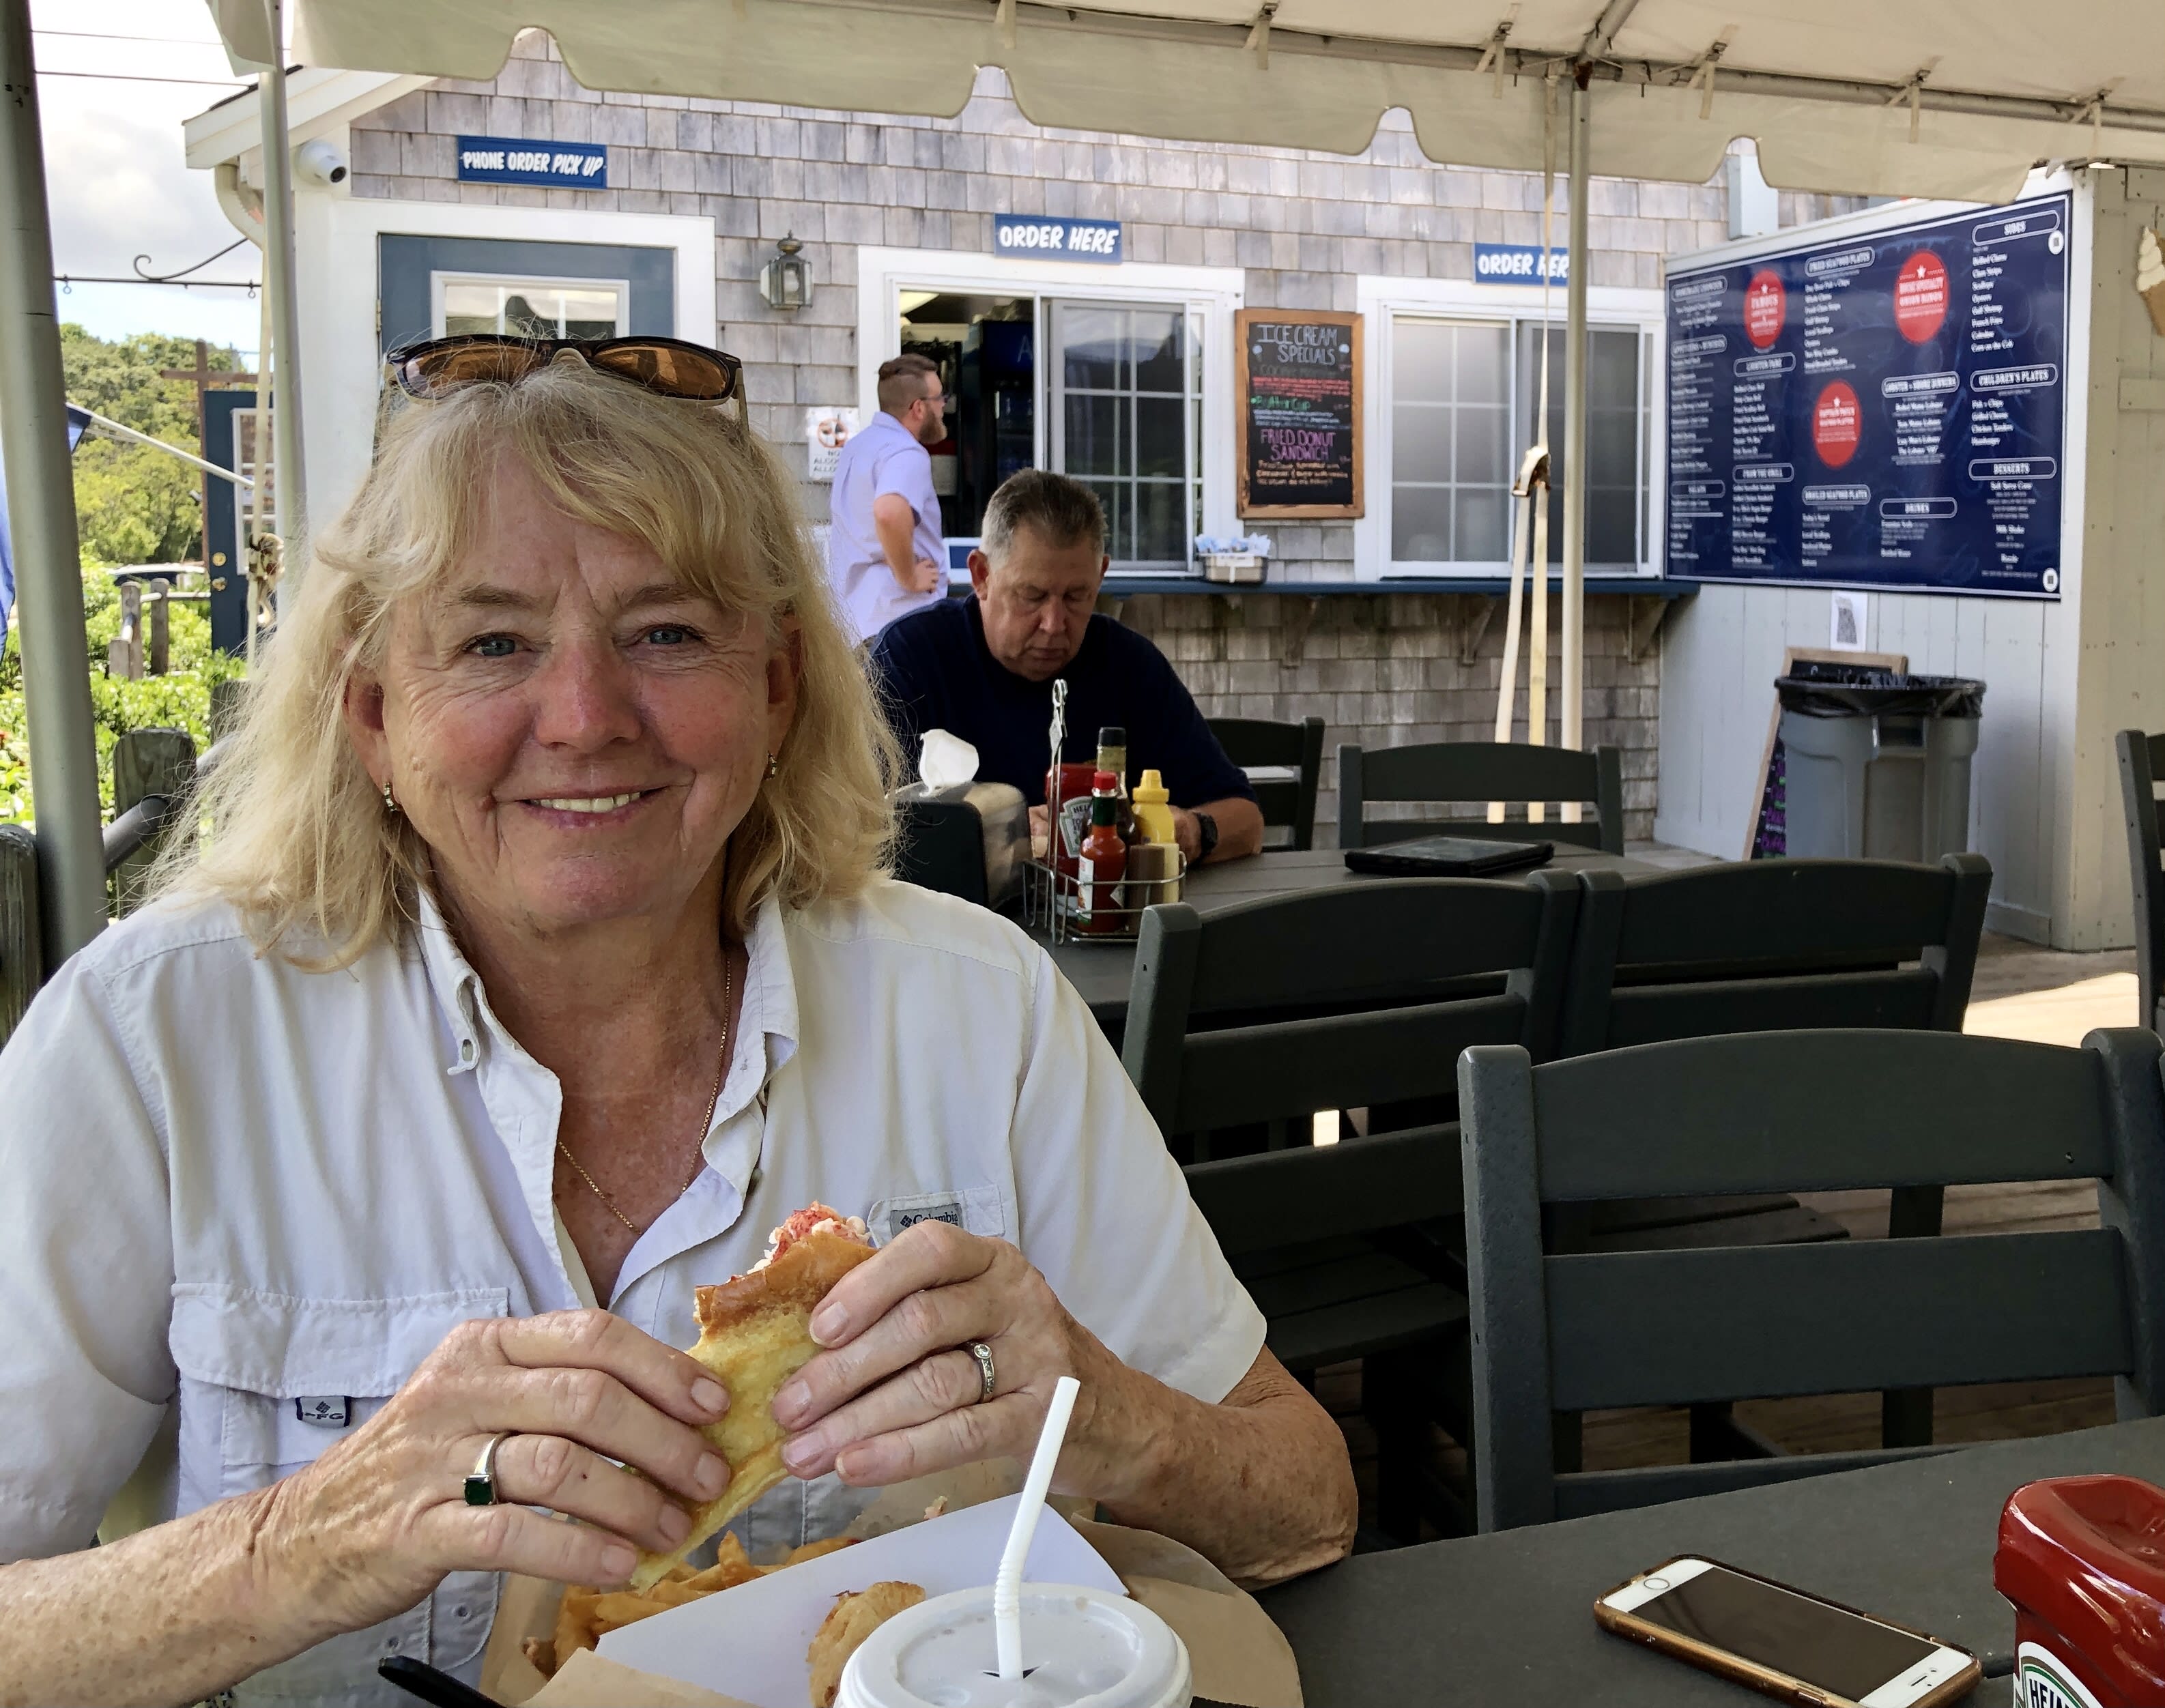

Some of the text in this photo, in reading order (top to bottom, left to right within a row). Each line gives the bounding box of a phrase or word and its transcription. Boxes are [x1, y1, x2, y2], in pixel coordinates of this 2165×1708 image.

[463, 151, 604, 177] PHONE ORDER PICK UP
[999, 225, 1119, 254] ORDER HERE
[1477, 252, 1570, 278] ORDER HER
[1257, 324, 1338, 347] ICE CREAM
[1277, 344, 1336, 366] SPECIALS
[2021, 369, 2049, 383] PLATES
[1260, 429, 1336, 448] FRIED DONUT
[1270, 445, 1329, 461] SANDWICH
[1073, 804, 1090, 813] HEI
